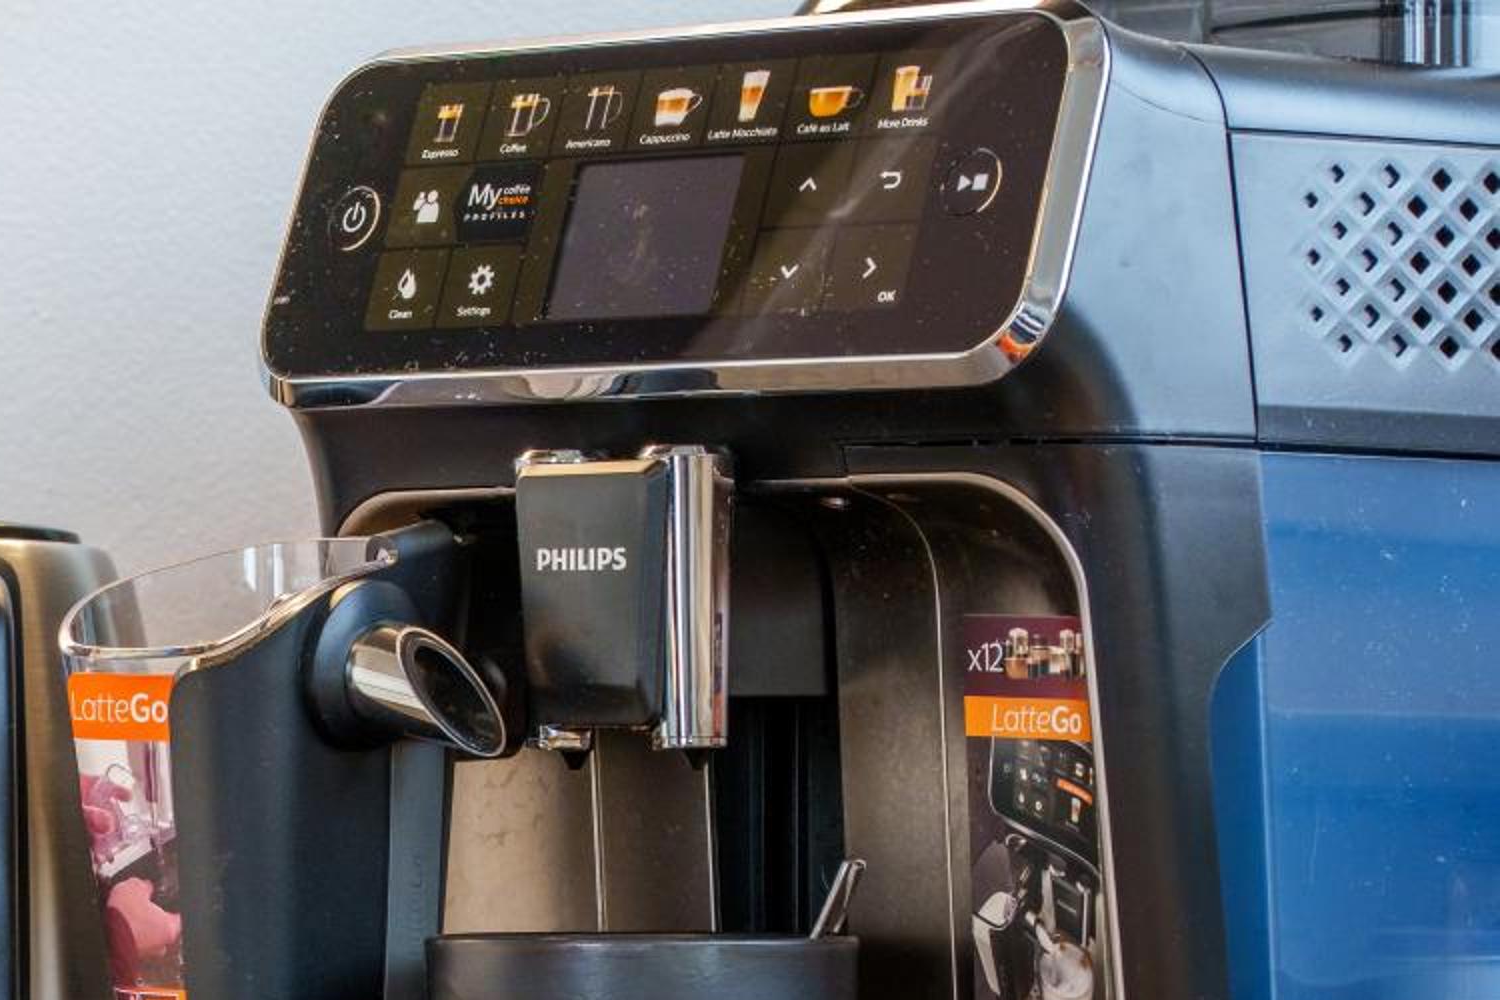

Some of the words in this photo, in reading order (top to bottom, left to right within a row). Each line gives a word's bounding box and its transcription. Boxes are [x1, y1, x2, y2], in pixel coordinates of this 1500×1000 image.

[565, 138, 611, 150] Americano
[639, 133, 691, 145] Cappuccino
[422, 148, 460, 160] Espresso
[467, 183, 503, 211] My
[878, 290, 896, 302] OK
[536, 546, 628, 572] PHILIPS
[967, 642, 1004, 672] x12
[70, 690, 169, 723] LatteGo
[991, 702, 1082, 736] LatteGo
